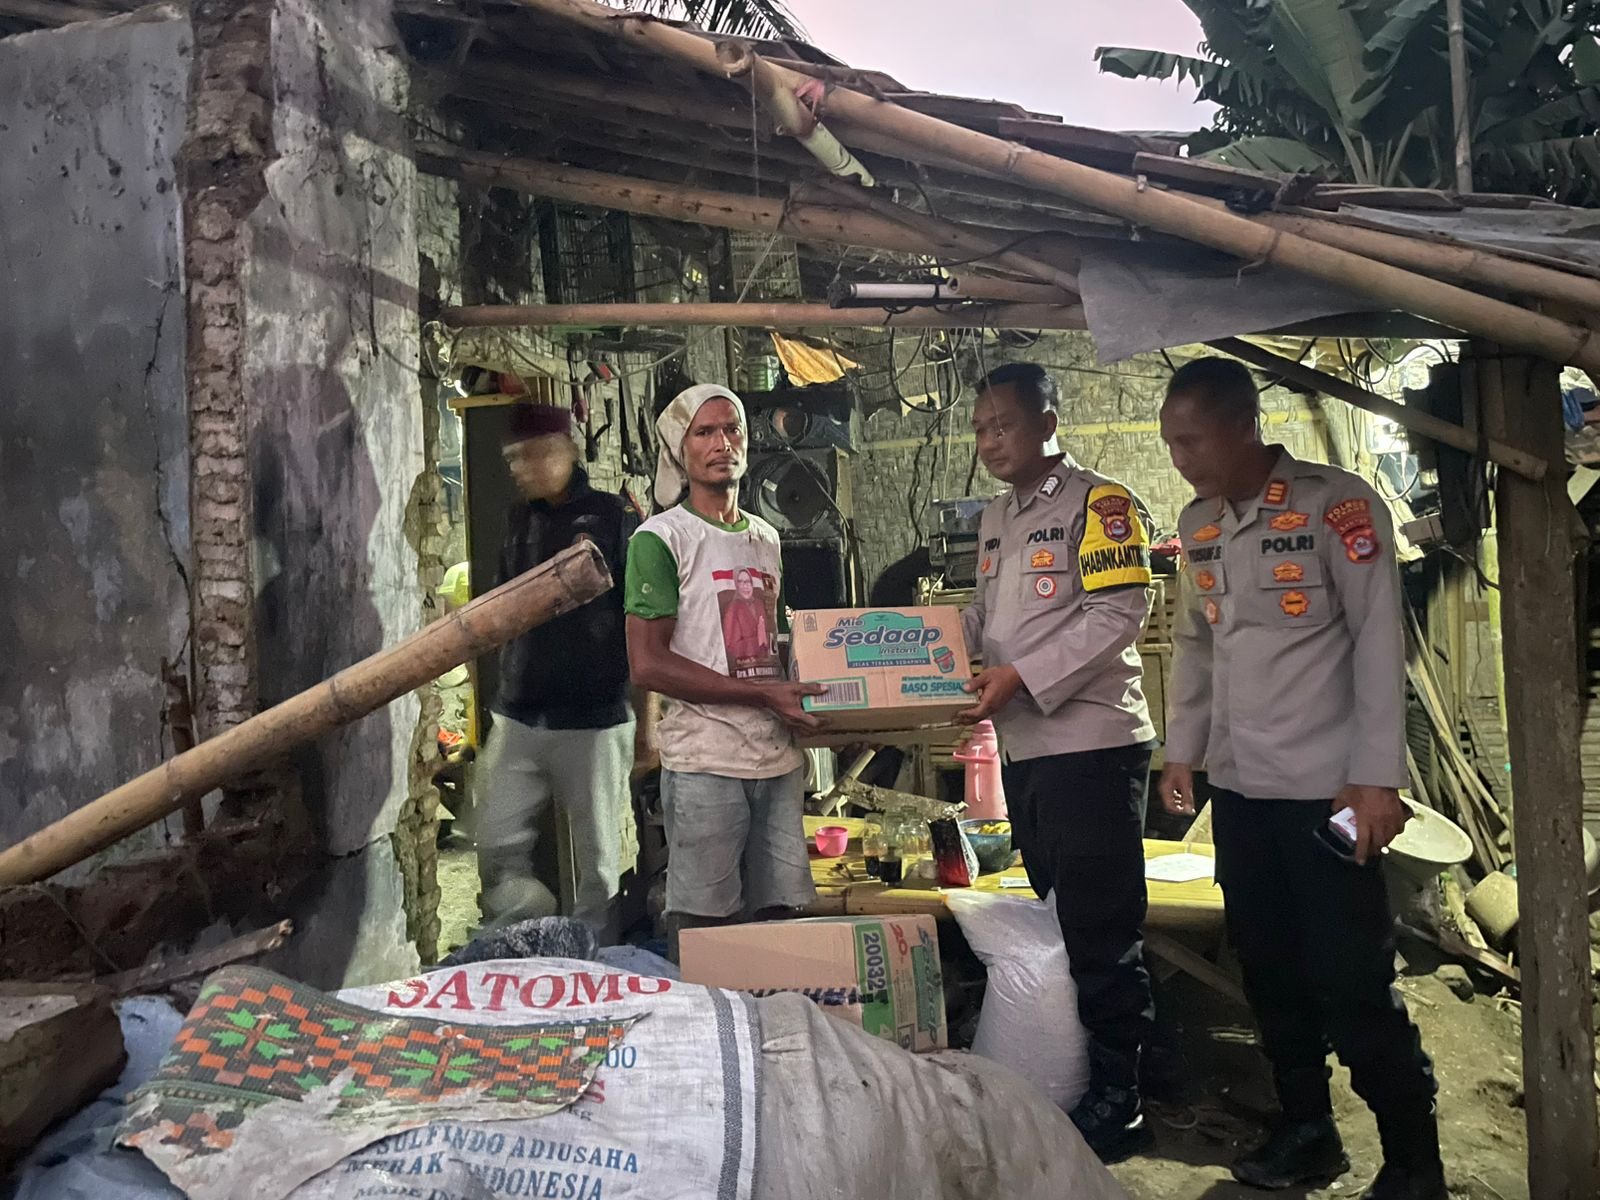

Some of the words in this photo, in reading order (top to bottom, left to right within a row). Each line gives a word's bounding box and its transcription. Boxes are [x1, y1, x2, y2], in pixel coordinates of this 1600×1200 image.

[1026, 527, 1065, 545] POLRI
[1261, 534, 1315, 554] POLRI
[838, 617, 865, 628] Mie
[824, 626, 941, 647] Sedaap
[901, 682, 928, 694] BASO
[864, 932, 887, 992] 20032
[376, 1124, 505, 1156] SULFINDO
[510, 1135, 639, 1174] ADIUSAHA
[344, 1152, 445, 1175] MERAK
